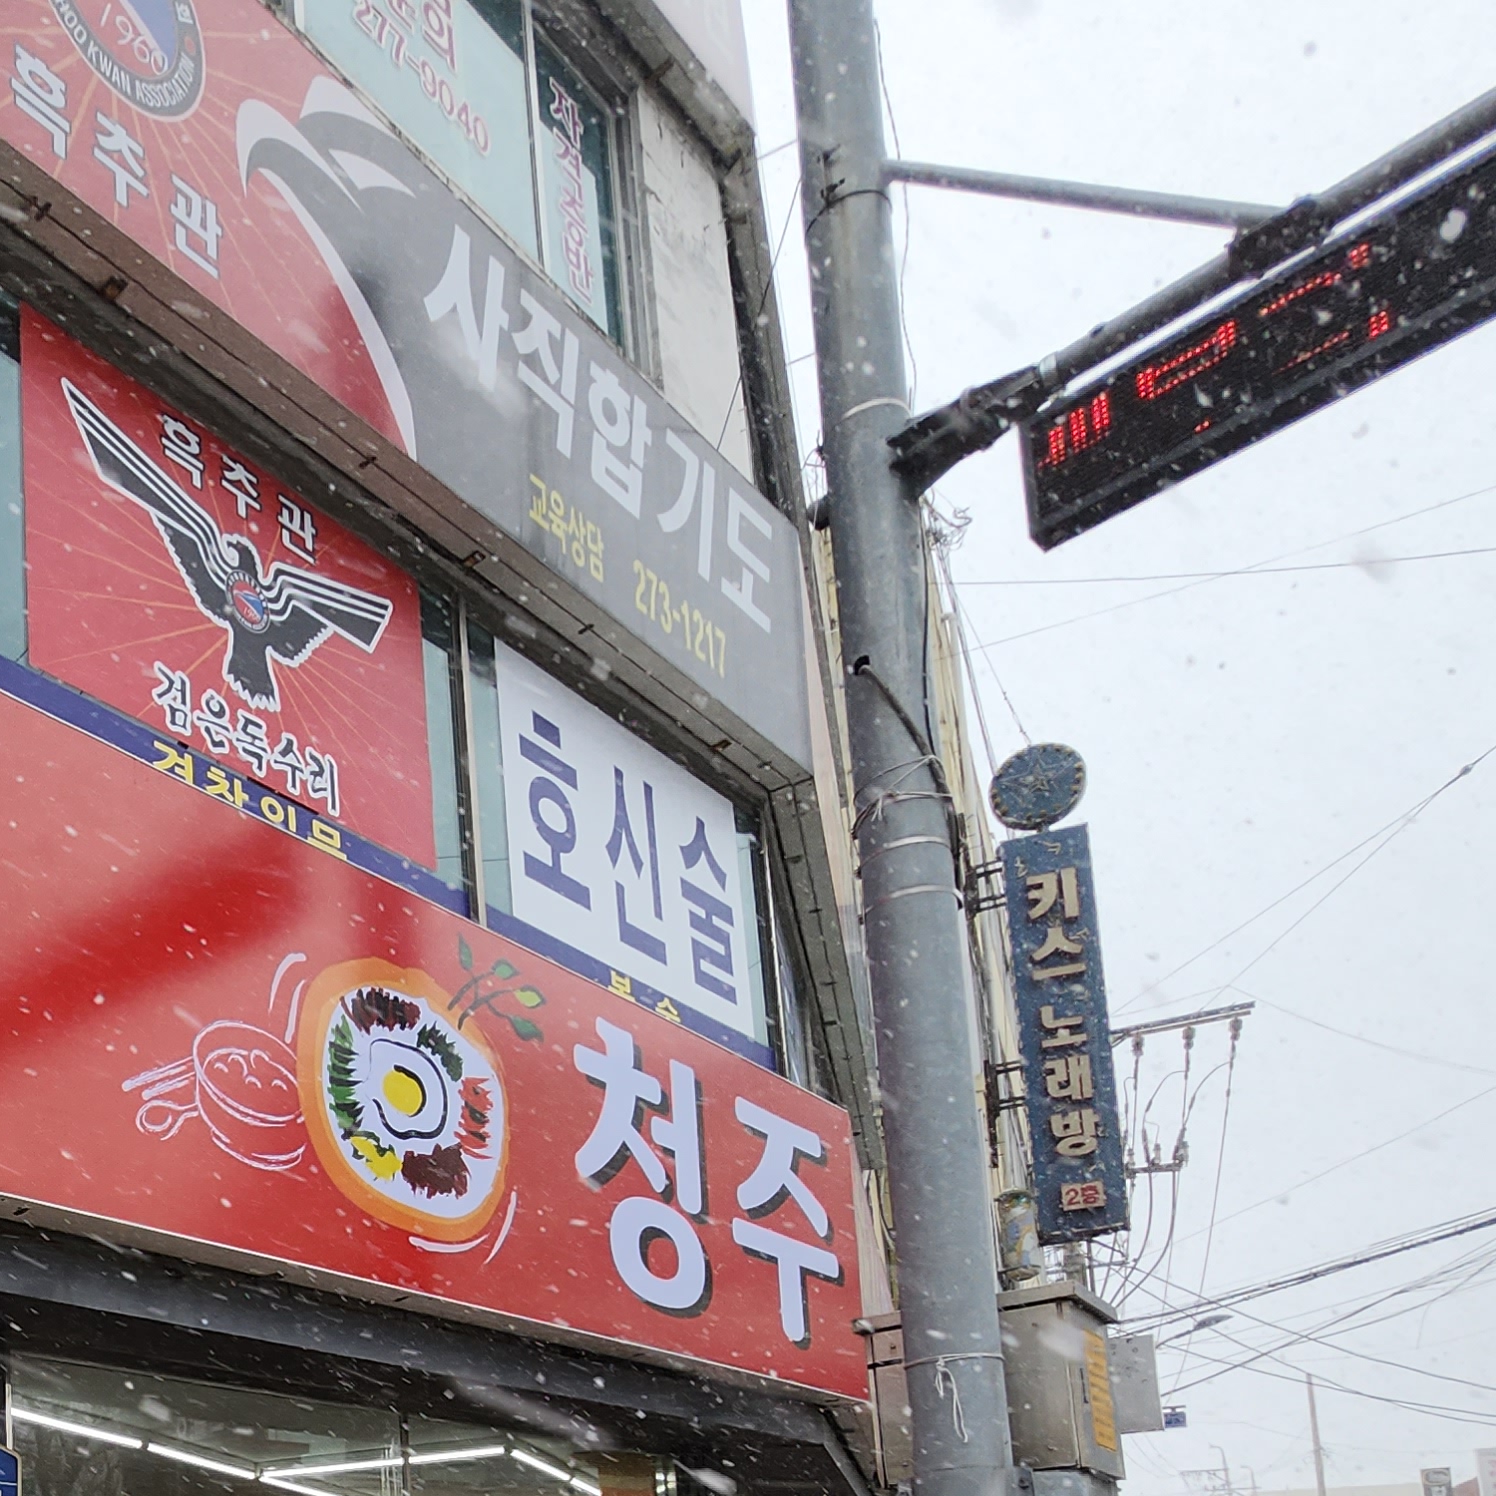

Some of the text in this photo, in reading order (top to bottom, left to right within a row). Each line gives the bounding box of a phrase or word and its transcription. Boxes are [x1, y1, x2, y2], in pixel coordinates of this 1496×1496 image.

[9, 42, 224, 279] 흑추관
[87, 40, 133, 97] KWAN
[135, 52, 196, 109] ASSOCIATION
[549, 75, 594, 307] 자격증반
[160, 413, 318, 566] 흑추관
[424, 223, 775, 635] 사직합기도
[528, 474, 728, 680] 교육상담 273-1217
[152, 660, 341, 818] 검은독수리
[518, 709, 740, 1009] 호신술
[572, 1016, 842, 1346] 청주
[1064, 1184, 1102, 1207] 2층
